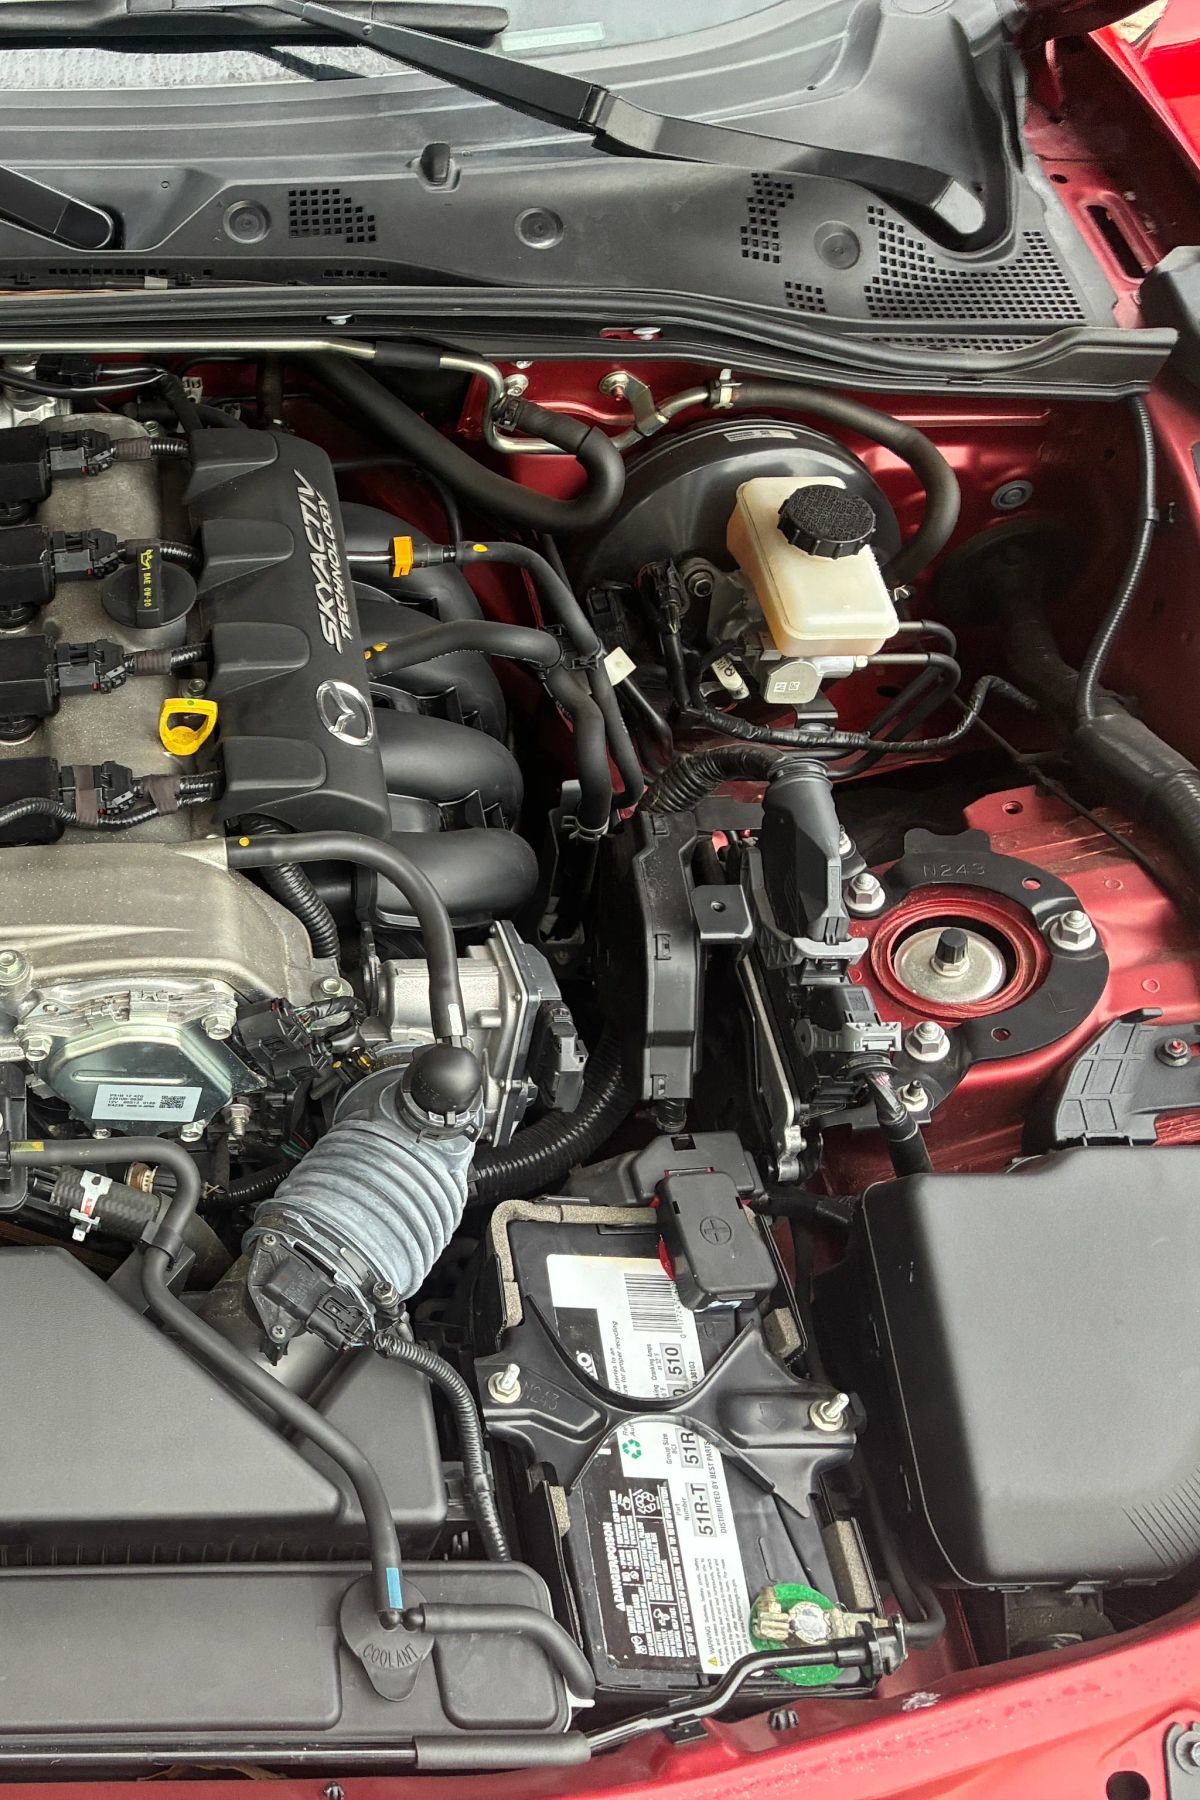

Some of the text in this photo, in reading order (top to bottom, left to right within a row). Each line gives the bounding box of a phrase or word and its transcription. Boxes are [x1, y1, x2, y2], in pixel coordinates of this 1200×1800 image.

[293, 468, 344, 655] SKYACTIV
[317, 487, 354, 642] TECHNOLOGY
[143, 587, 152, 606] 0W-20
[611, 1321, 621, 1348] recycling
[617, 1351, 625, 1371] proper
[648, 1359, 657, 1379] Cranking
[664, 1347, 682, 1374] 510
[661, 1433, 672, 1463] Group Size
[679, 1432, 699, 1463] 51R
[707, 1463, 716, 1478] BEST
[681, 1497, 690, 1519] Number
[689, 1482, 714, 1534] 51R-T
[712, 1491, 727, 1532] DISTRIBUTED
[602, 1521, 624, 1602] DANGER/POISON
[363, 1642, 418, 1668] COOLANT
